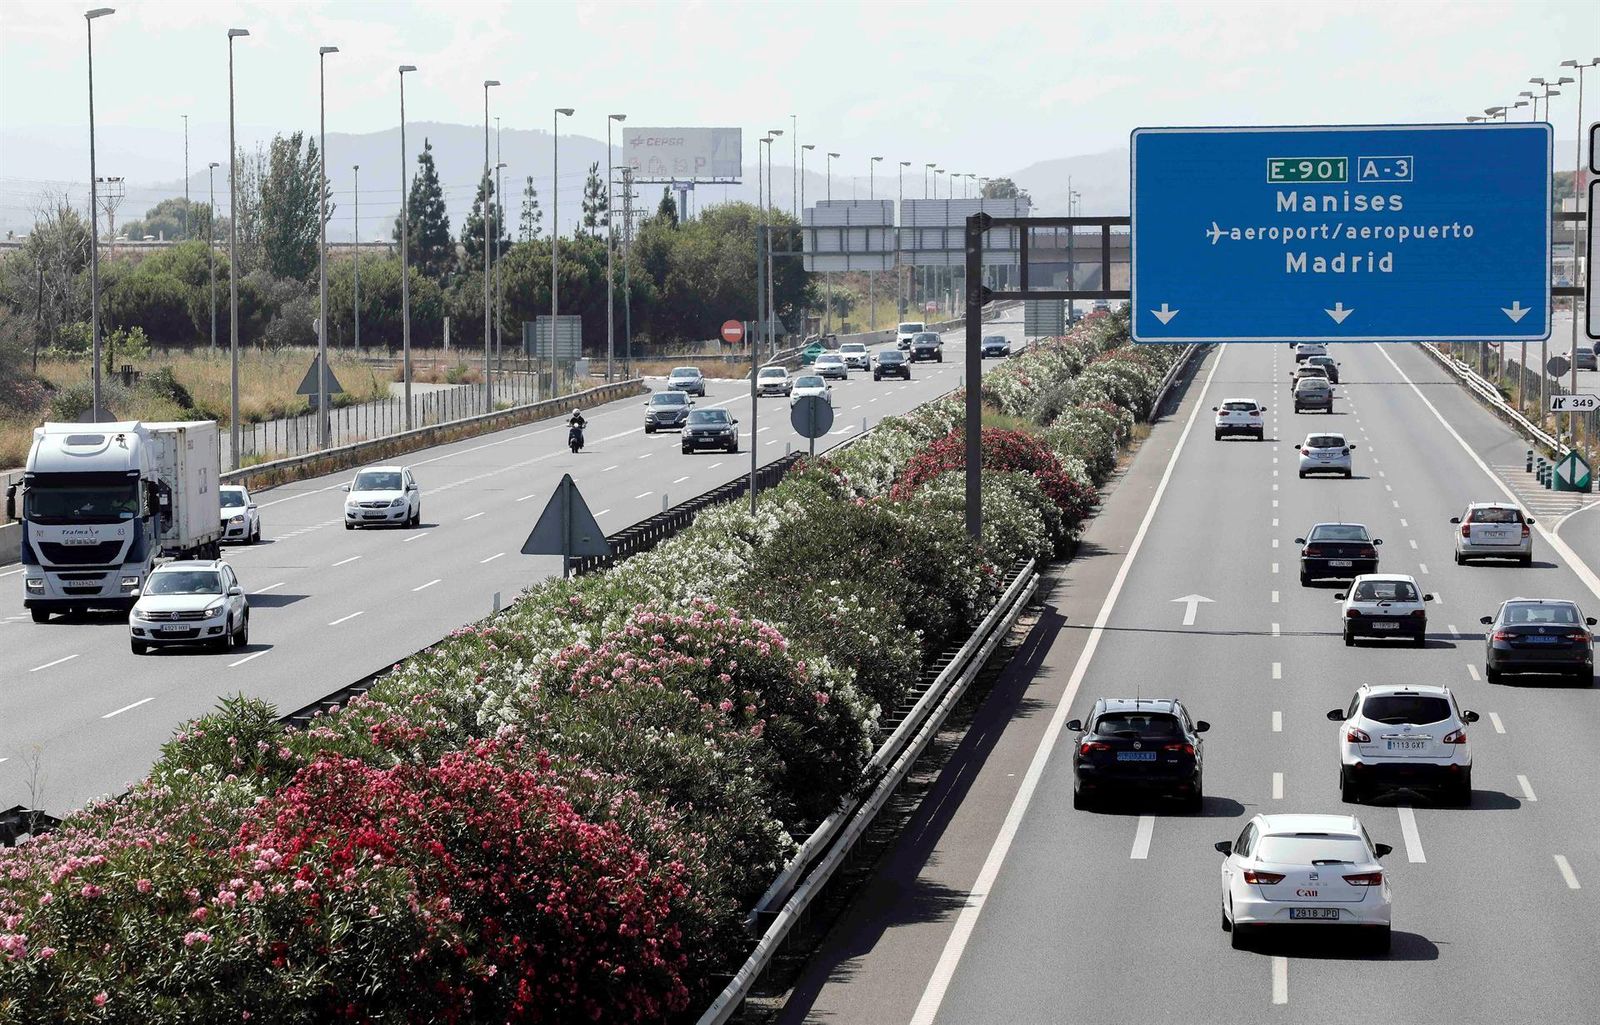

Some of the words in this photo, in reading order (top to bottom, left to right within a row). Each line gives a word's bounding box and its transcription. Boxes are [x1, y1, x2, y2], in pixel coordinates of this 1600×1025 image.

[646, 137, 684, 146] CEPSA
[1270, 160, 1345, 179] E-901
[1362, 159, 1409, 178] A-3
[1276, 190, 1404, 213] Manises
[1230, 222, 1475, 244] aeroport/aeropuerto
[1285, 251, 1394, 273] Madrid
[1572, 399, 1594, 407] 349
[1392, 741, 1410, 749] 1113
[1411, 741, 1425, 749] GXT
[1295, 909, 1318, 918] 2918
[1321, 909, 1338, 918] JPD
